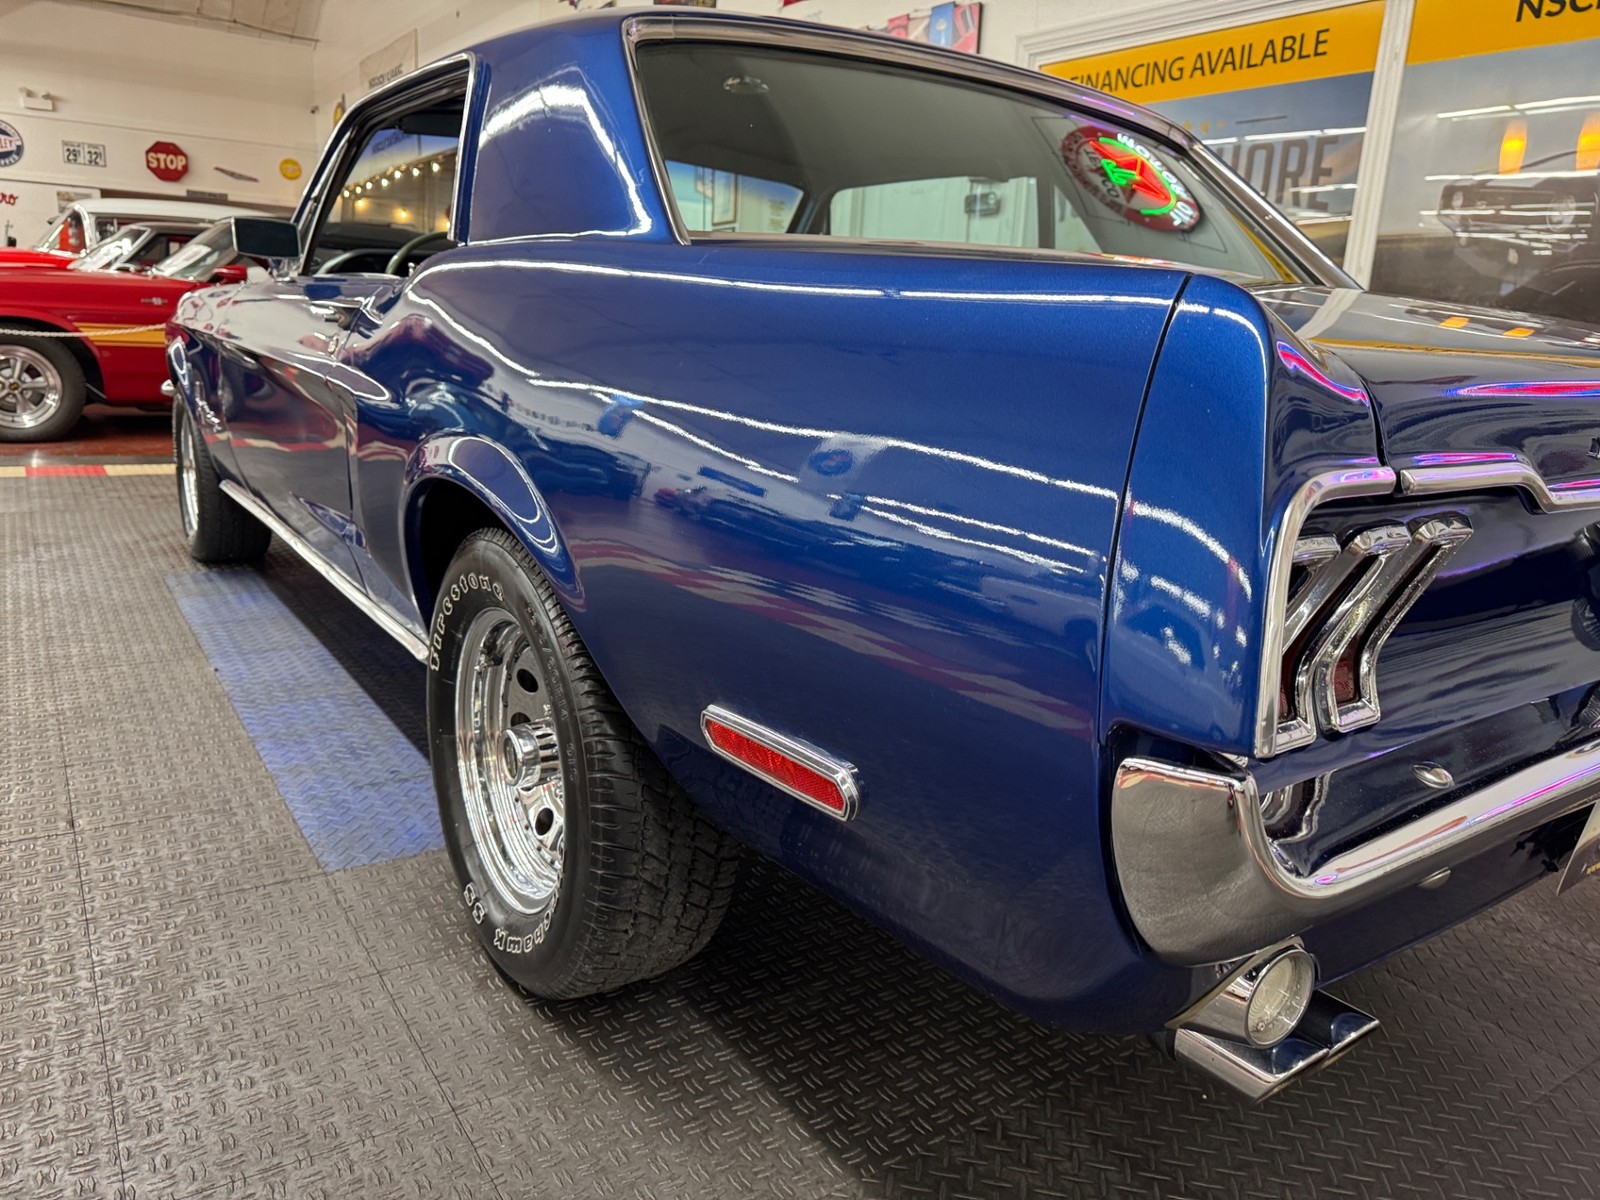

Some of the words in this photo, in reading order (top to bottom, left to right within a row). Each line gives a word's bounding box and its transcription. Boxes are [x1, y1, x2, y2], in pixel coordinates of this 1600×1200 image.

[1189, 28, 1330, 78] AVAILABLE
[147, 152, 187, 171] STOP
[463, 882, 486, 925] SS
